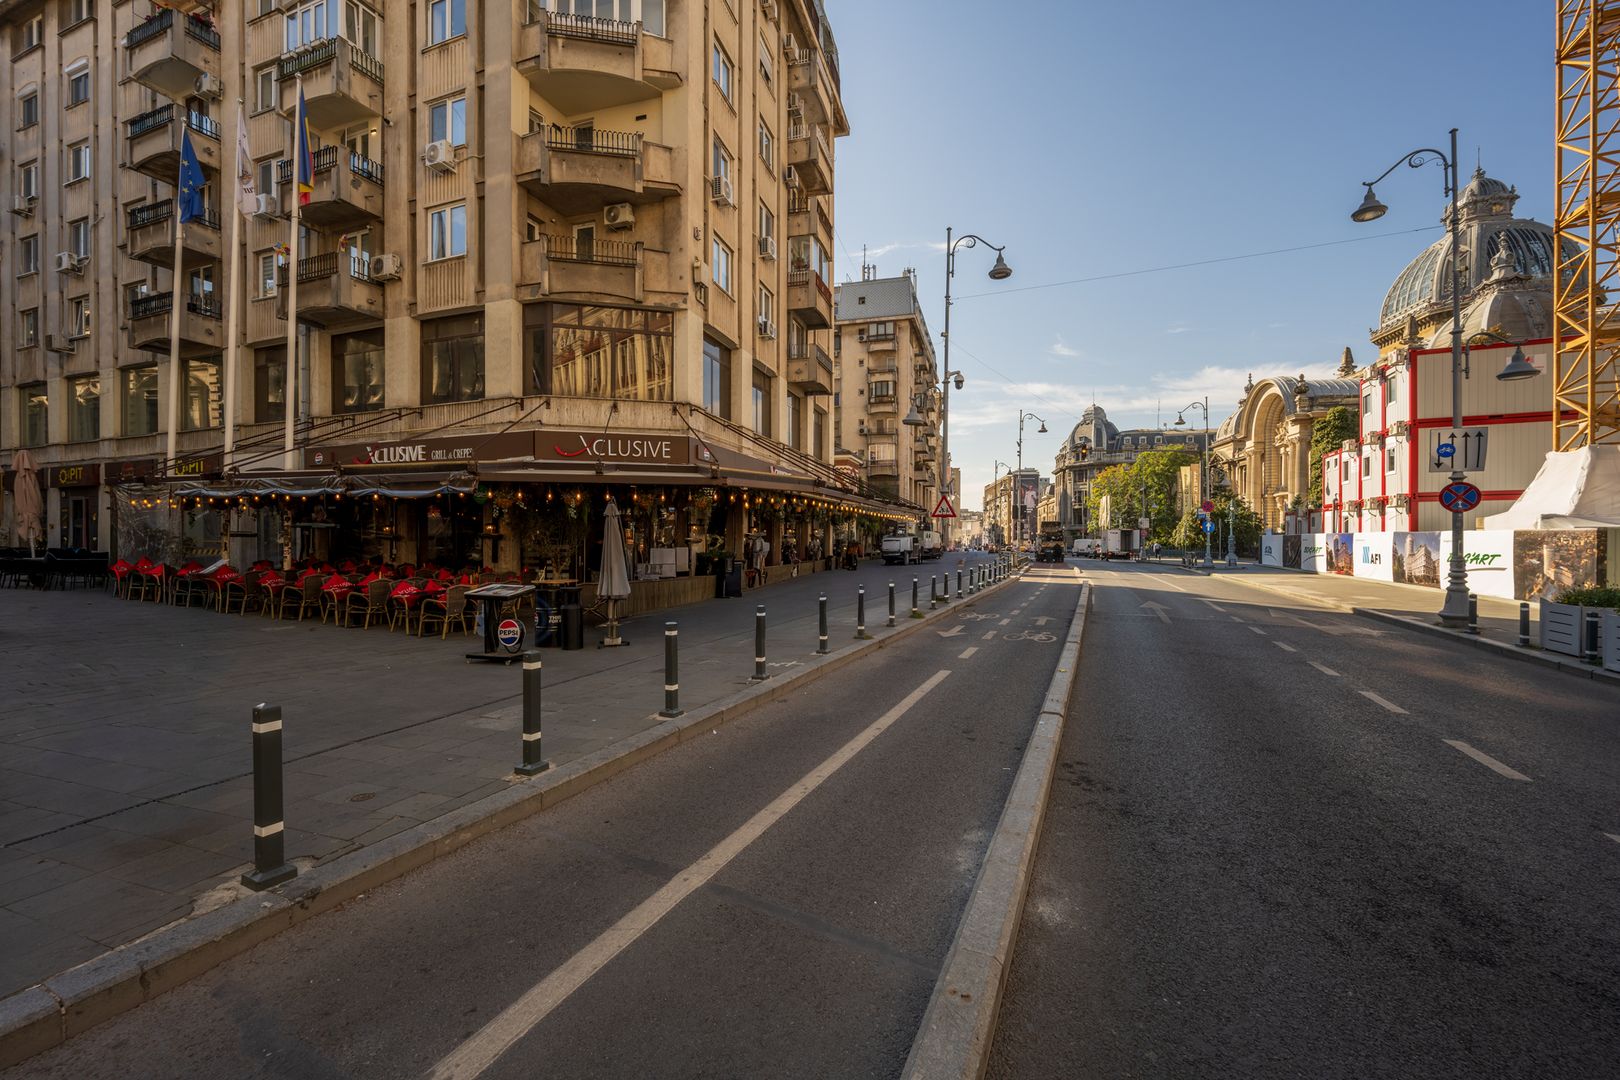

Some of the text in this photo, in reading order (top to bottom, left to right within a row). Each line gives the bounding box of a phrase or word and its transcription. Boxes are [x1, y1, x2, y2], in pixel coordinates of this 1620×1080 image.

[354, 443, 427, 464] XCLUSIVE
[431, 449, 447, 460] GRILL
[555, 435, 672, 459] XCLUSIVE
[1370, 553, 1382, 565] AFI
[499, 629, 519, 637] PEPSI
